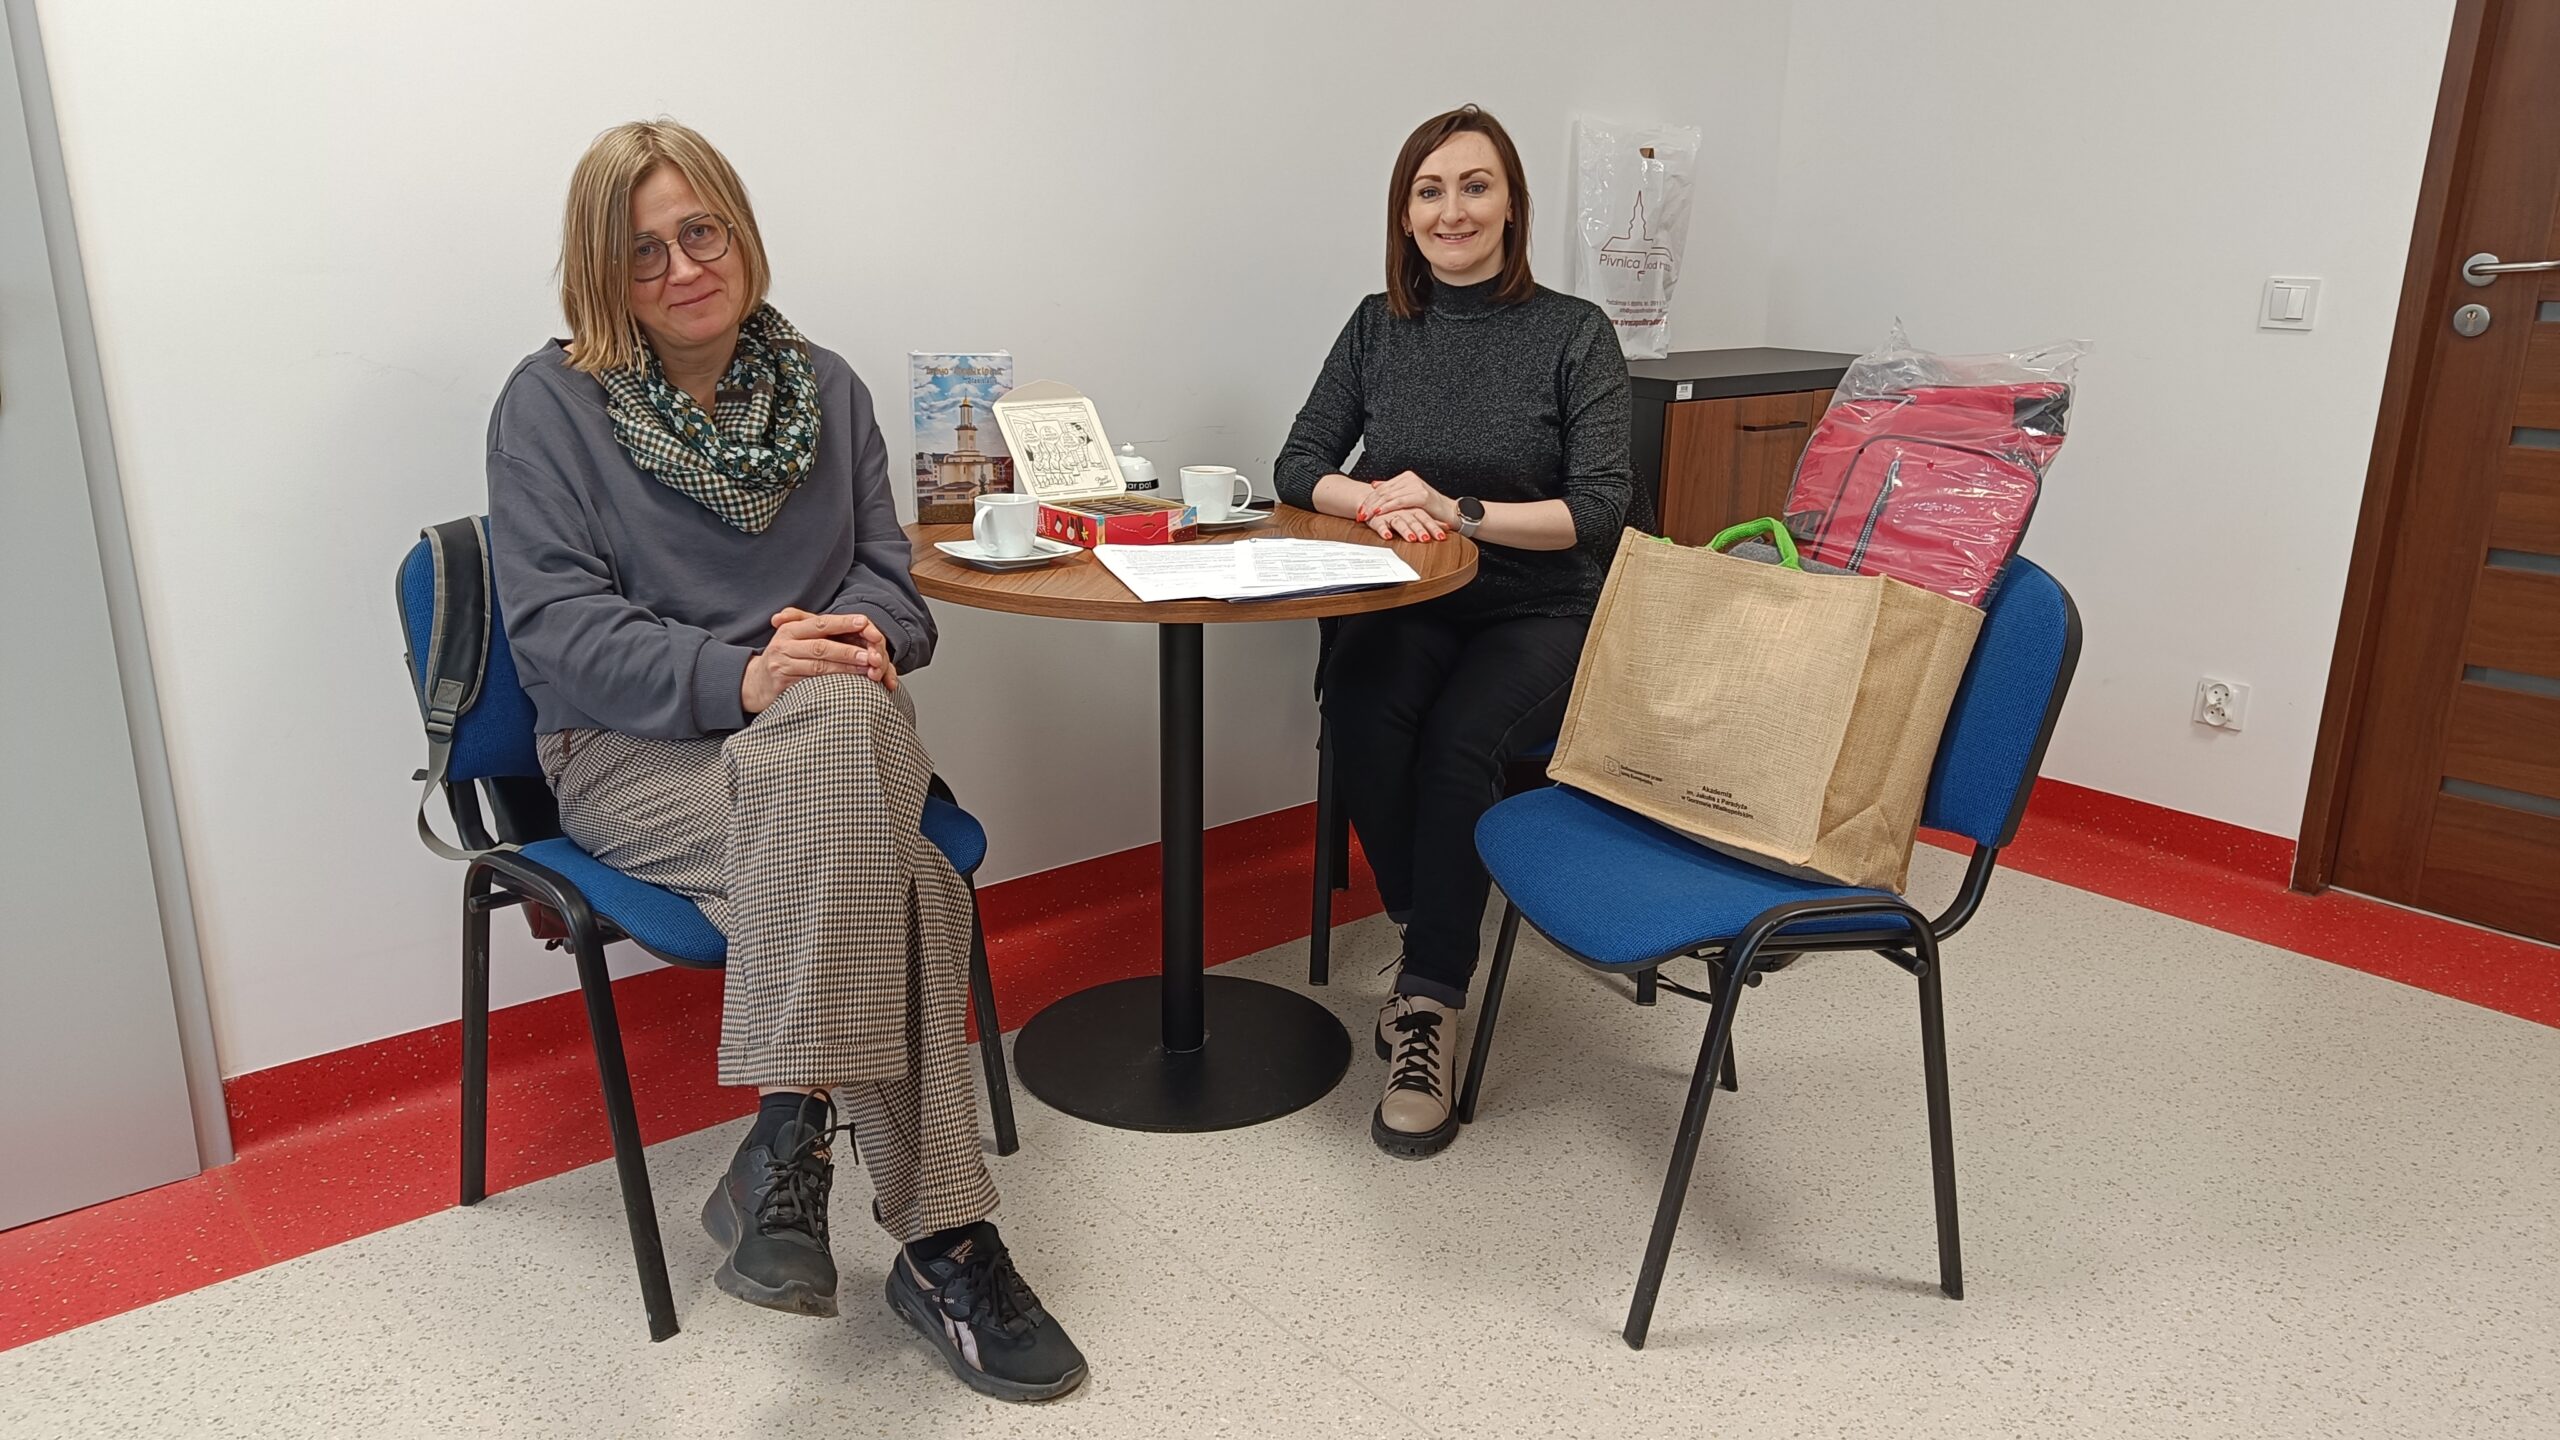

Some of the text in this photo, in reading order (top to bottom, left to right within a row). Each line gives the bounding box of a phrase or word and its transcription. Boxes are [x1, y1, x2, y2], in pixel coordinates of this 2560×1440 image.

[1599, 253, 1641, 269] Pivnica
[1139, 481, 1152, 492] pot
[1702, 786, 1733, 799] Akademia
